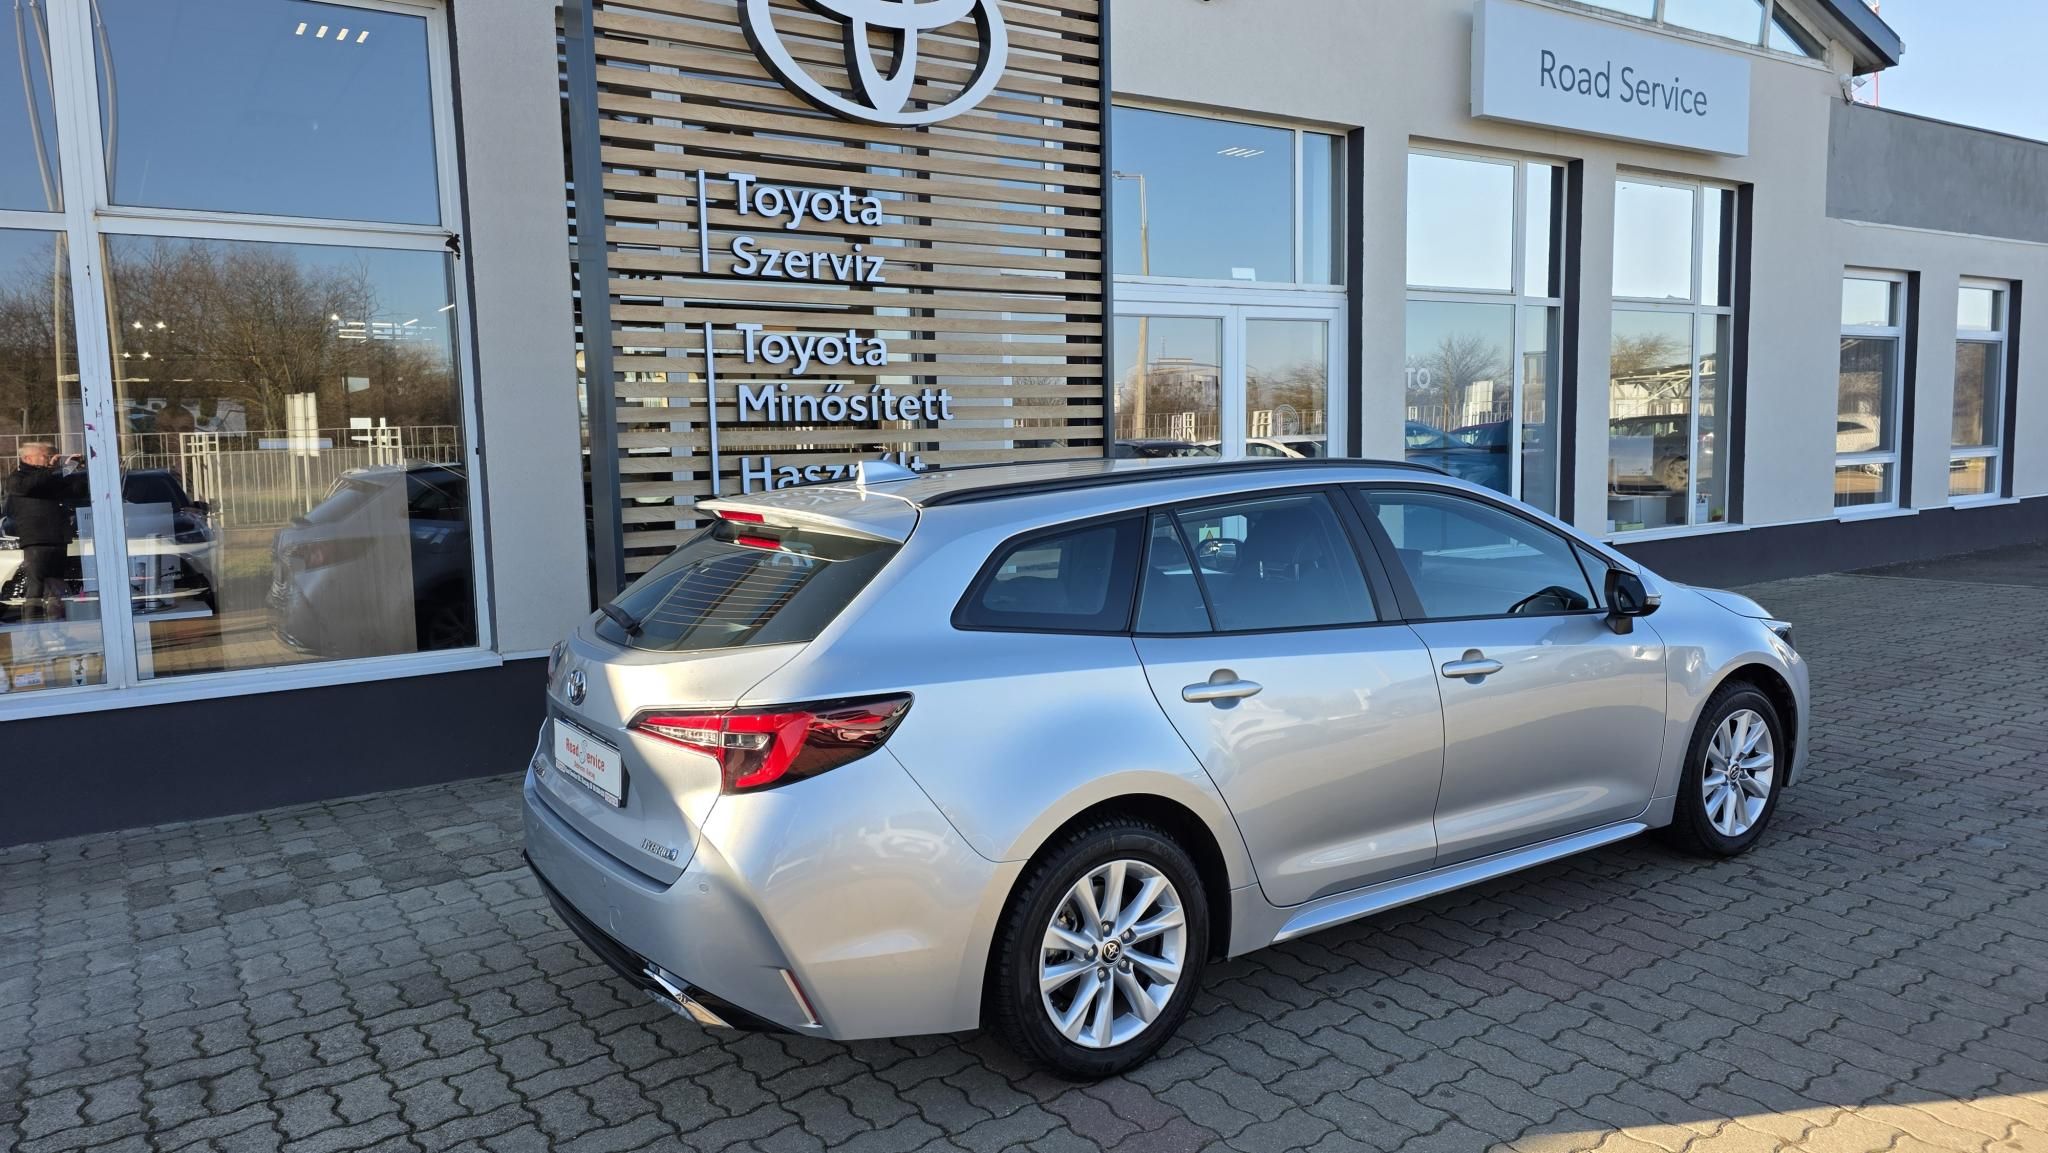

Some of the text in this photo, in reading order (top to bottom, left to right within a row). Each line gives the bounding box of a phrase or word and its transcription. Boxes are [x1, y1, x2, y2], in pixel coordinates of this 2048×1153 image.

[1540, 49, 1708, 117] Road Service
[728, 172, 883, 230] Toyota
[731, 236, 886, 283] Szerviz
[735, 322, 888, 375] Toyota
[737, 383, 954, 422] Minősített
[739, 451, 926, 496] Hasz
